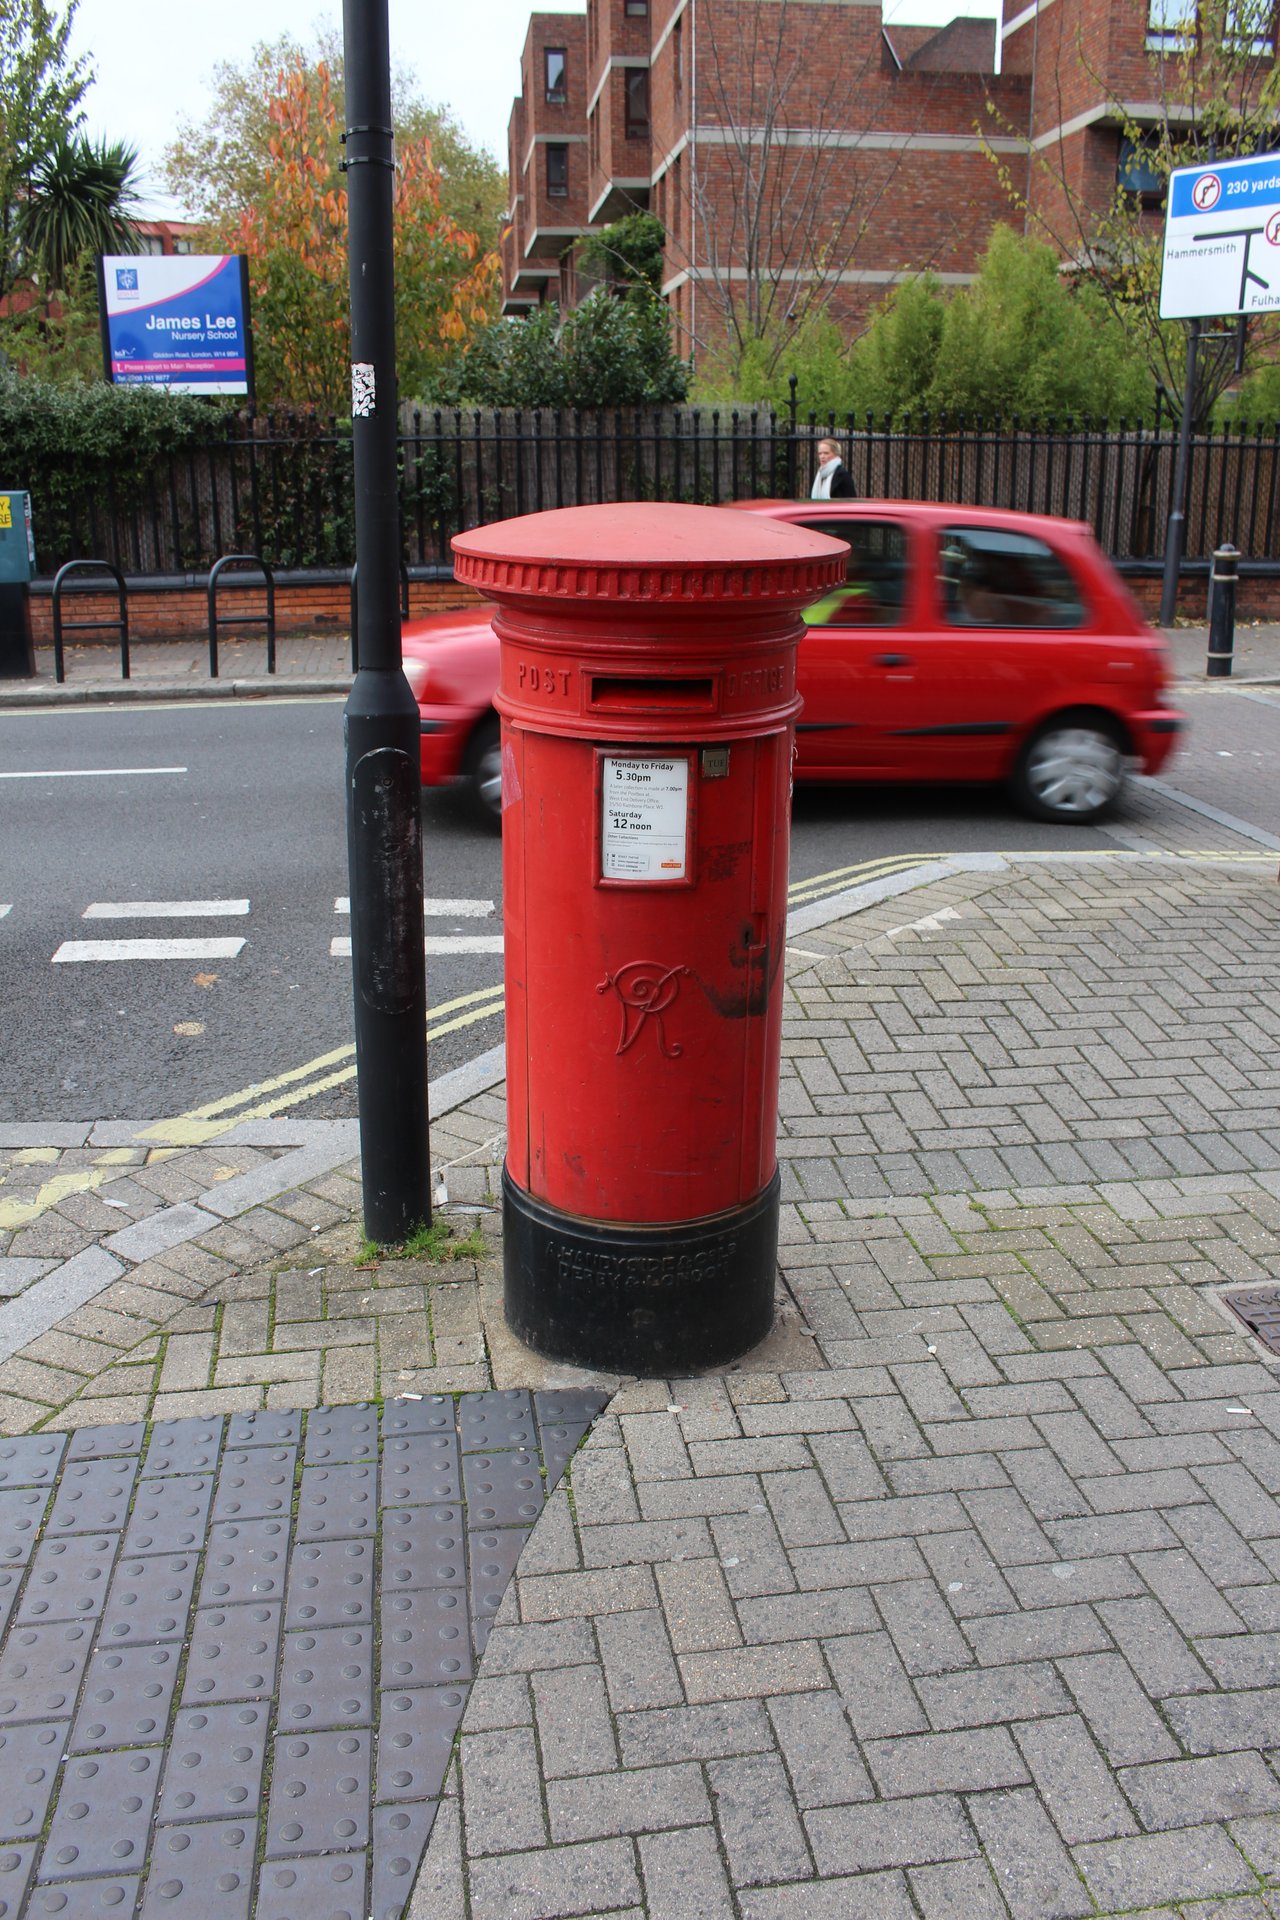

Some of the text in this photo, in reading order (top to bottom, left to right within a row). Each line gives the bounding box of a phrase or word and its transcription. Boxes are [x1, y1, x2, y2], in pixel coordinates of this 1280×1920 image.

[1227, 175, 1280, 195] 230 yards
[1166, 243, 1237, 260] Hammersmith
[1251, 294, 1280, 307] Fulha
[145, 313, 237, 330] James Lee
[171, 330, 238, 342] Nursery School
[519, 662, 785, 697] POST OFFICE
[611, 760, 640, 770] Monday
[650, 763, 674, 771] Friday
[616, 769, 651, 783] 5.30pm
[609, 809, 642, 819] Saturday
[613, 818, 628, 829] 12
